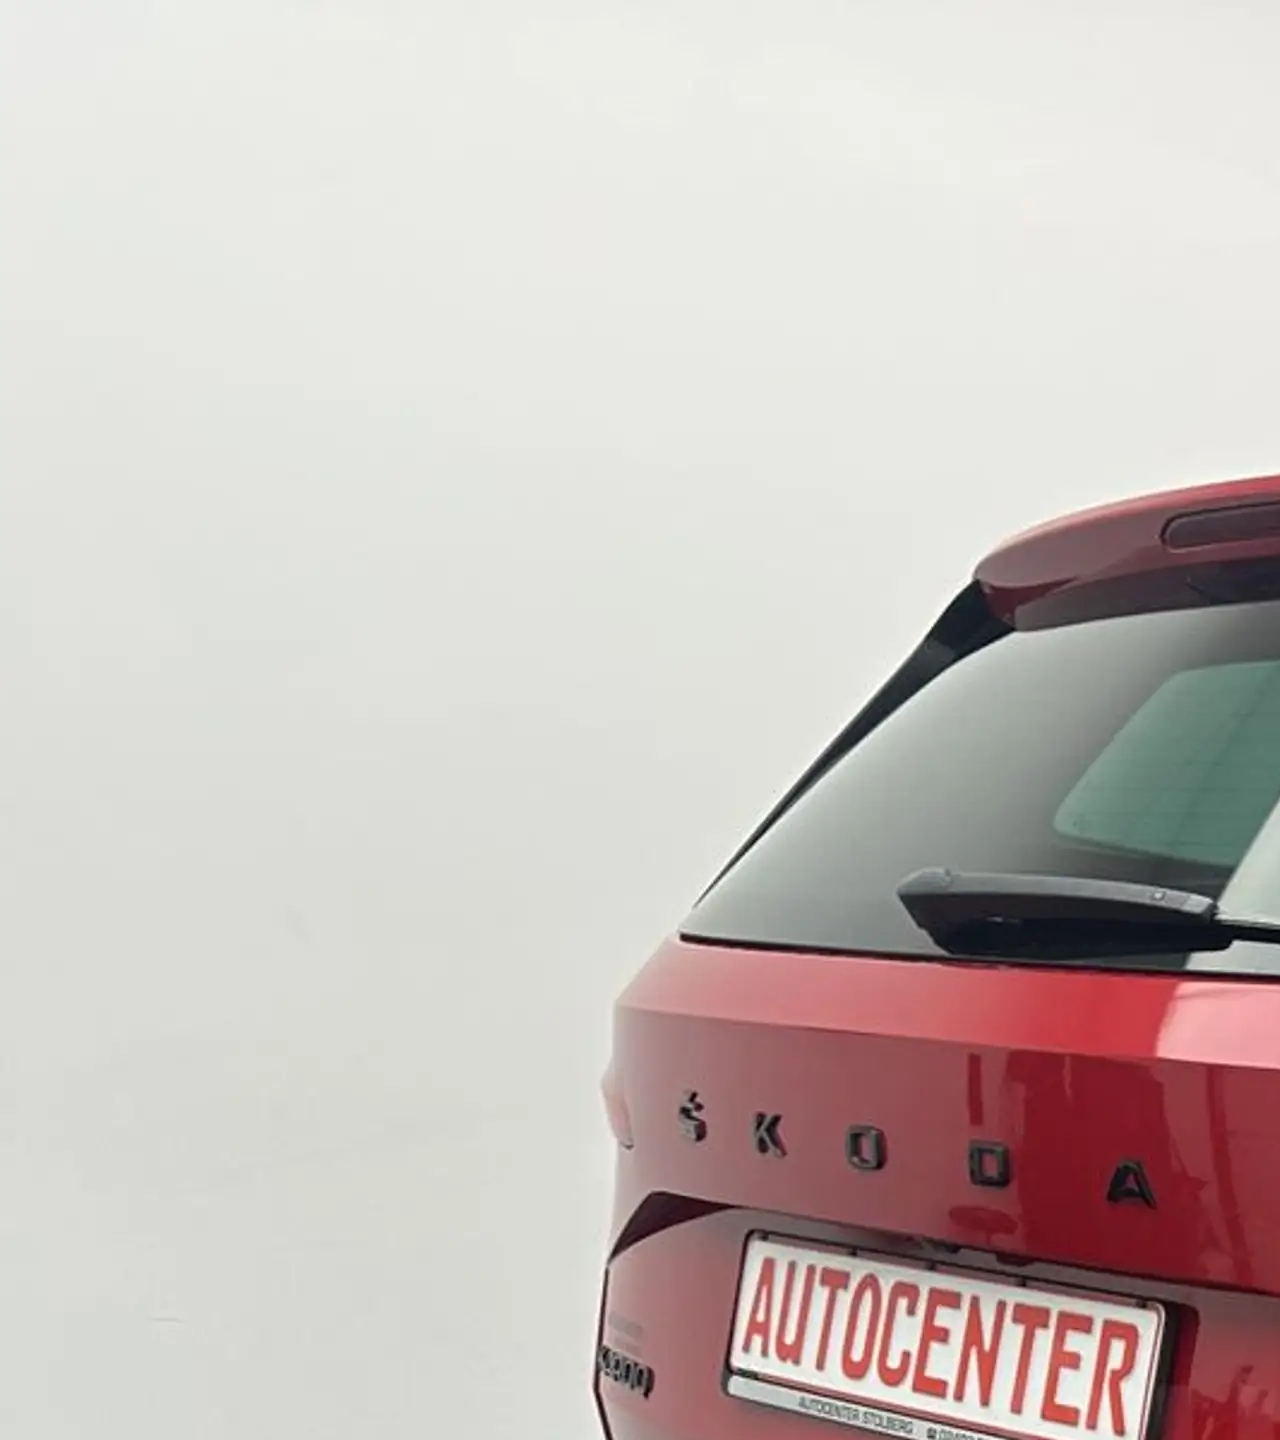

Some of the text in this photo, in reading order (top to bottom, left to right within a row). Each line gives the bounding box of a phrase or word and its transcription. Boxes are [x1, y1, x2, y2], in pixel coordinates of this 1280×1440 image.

[679, 1091, 1157, 1210] ŠKODA
[742, 1258, 1139, 1437] AUTOCENTER
[863, 1410, 914, 1435] STOLBERG
